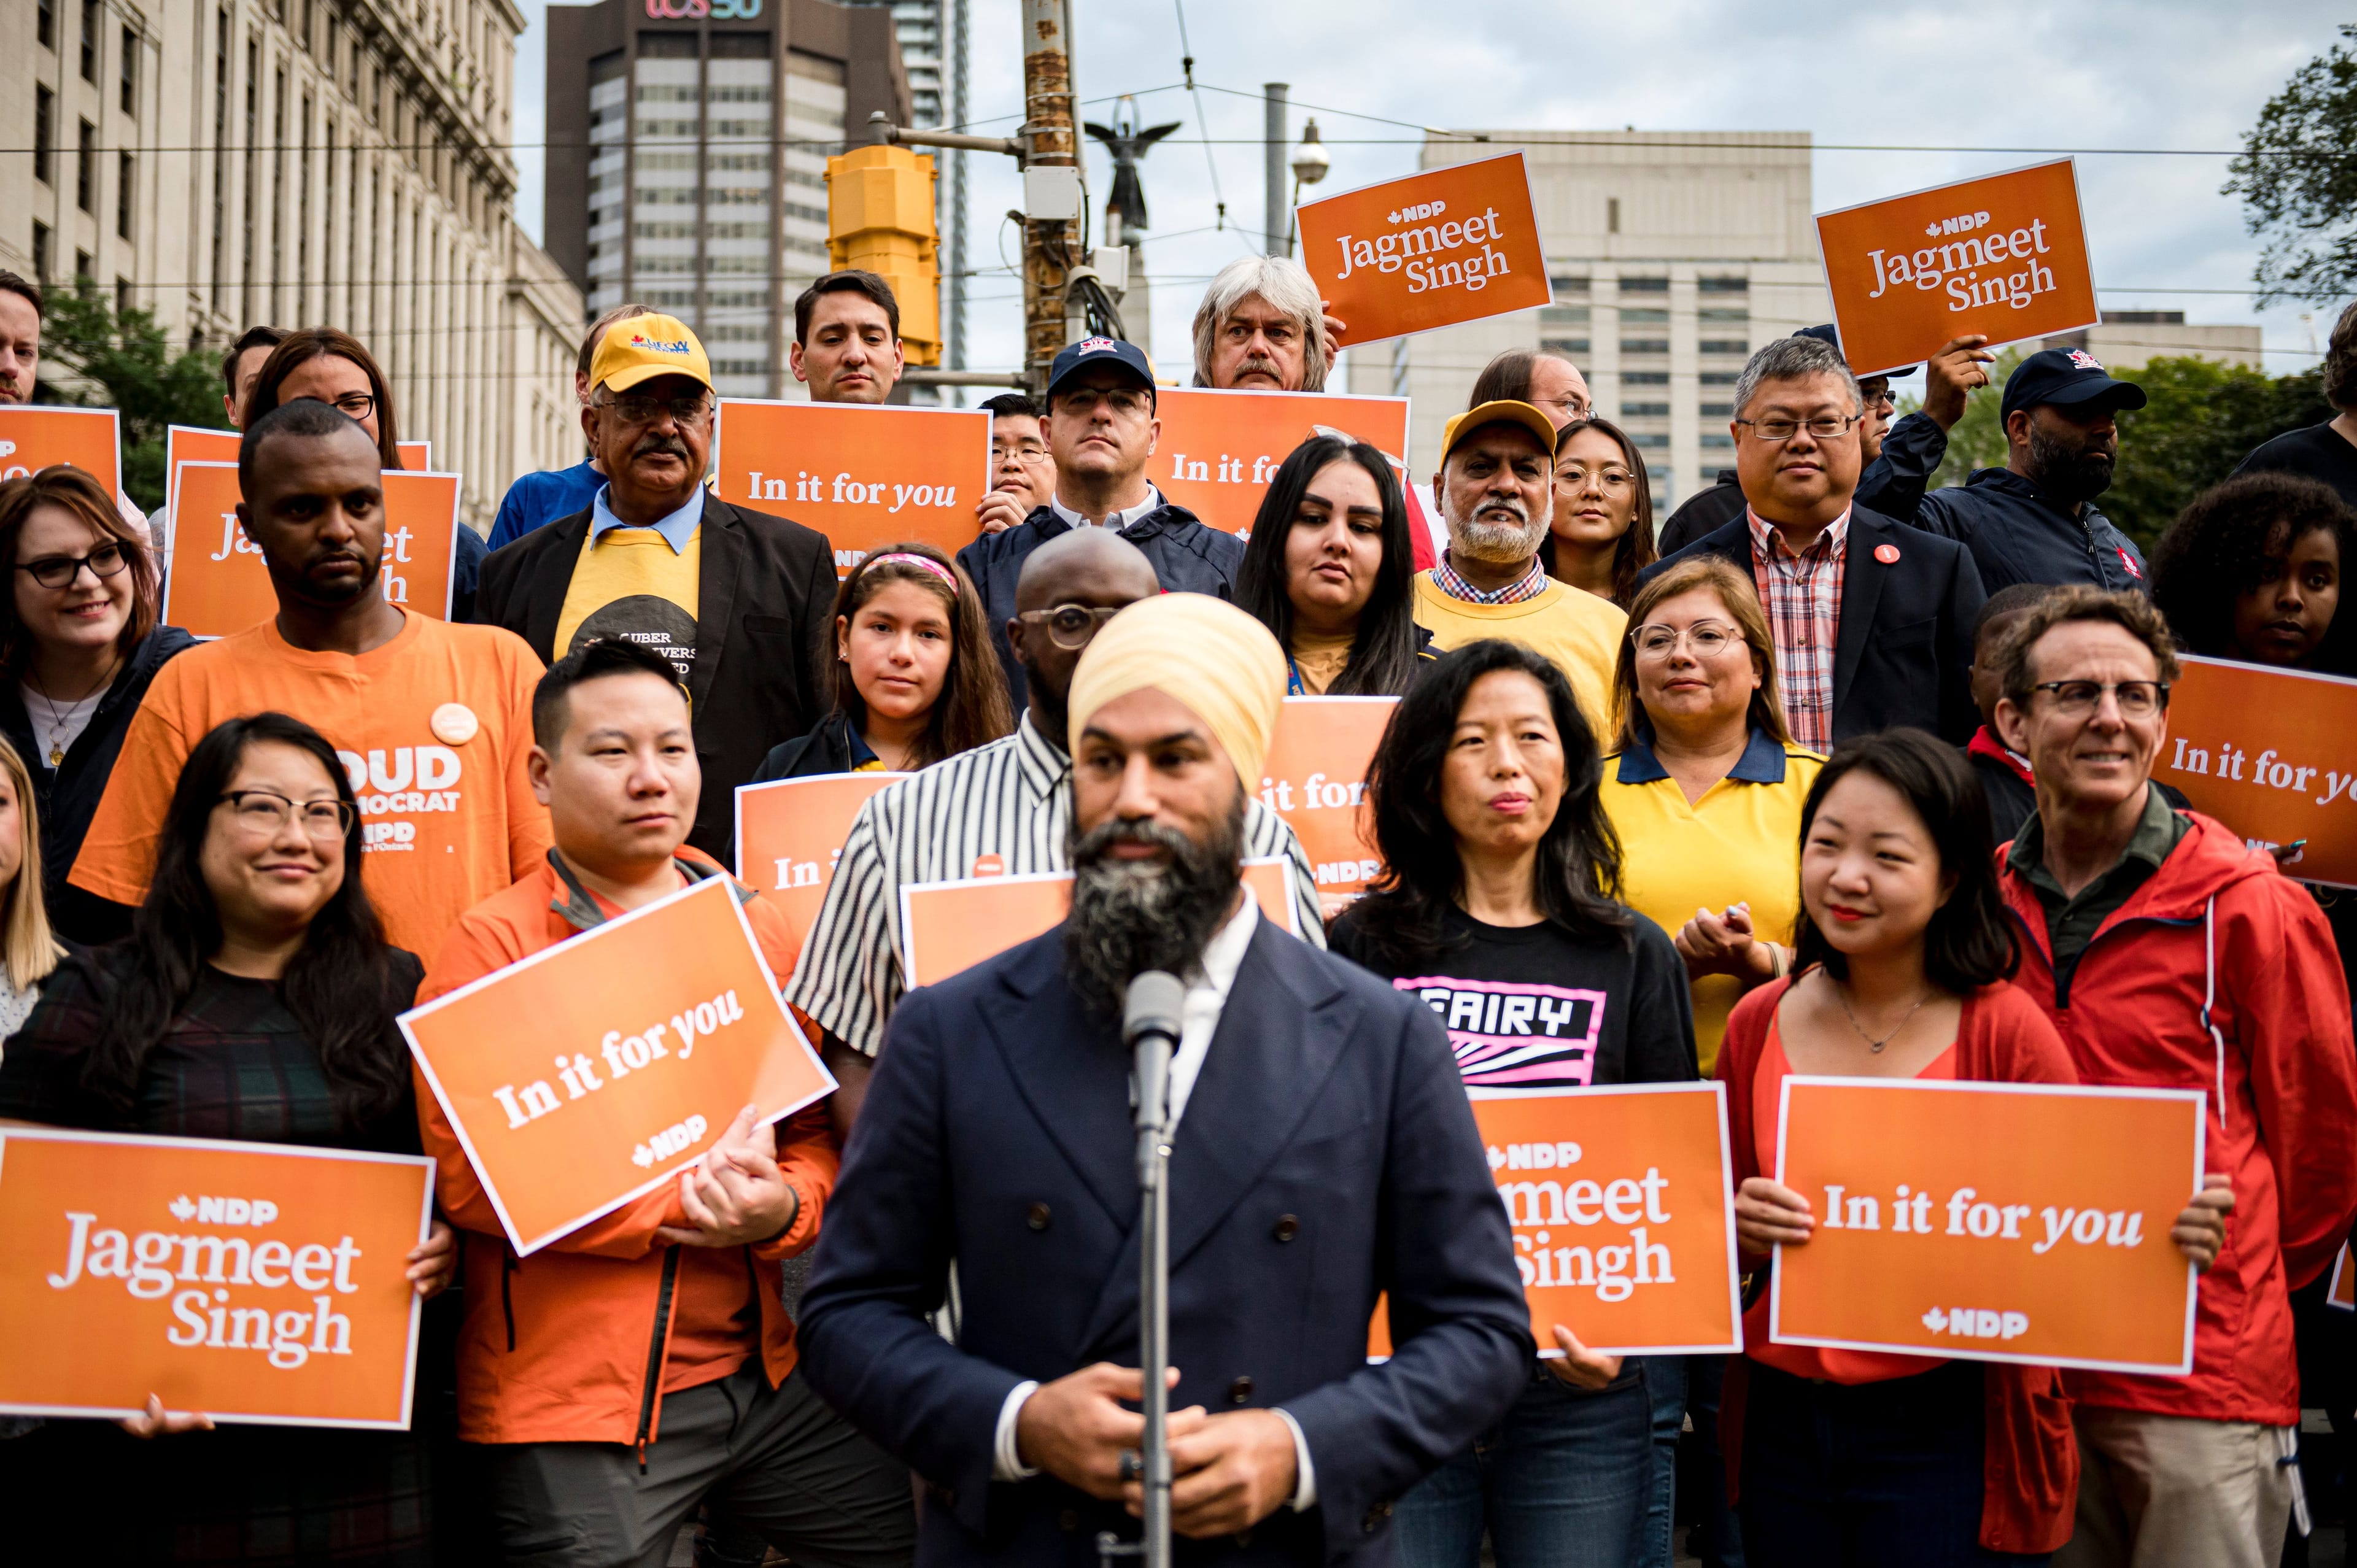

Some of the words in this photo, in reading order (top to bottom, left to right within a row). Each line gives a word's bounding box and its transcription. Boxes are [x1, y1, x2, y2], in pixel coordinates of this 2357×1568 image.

[1402, 200, 1446, 223] NDP
[1942, 210, 1991, 236] NDP
[1336, 207, 1503, 280] Jagmeet
[1867, 218, 2051, 298] Jagmeet
[1406, 244, 1511, 293] Singh
[1946, 257, 2057, 312] Singh
[1171, 454, 1209, 482] In
[1217, 454, 1244, 484] it
[748, 471, 788, 501] In
[796, 471, 823, 503] it
[832, 472, 886, 504] for
[888, 484, 956, 514] you
[834, 549, 868, 568] ND
[630, 632, 672, 644] UBER
[2170, 737, 2209, 774] In
[2216, 742, 2246, 781] it
[2252, 749, 2318, 792] for
[1260, 776, 1296, 812] it
[1302, 771, 1369, 809] for
[774, 857, 821, 890] In
[1317, 859, 1381, 885] NDP
[493, 1079, 562, 1130] In
[554, 1052, 604, 1100] it
[600, 1023, 669, 1079] for
[670, 989, 744, 1059] you
[649, 1114, 708, 1162] NDP
[1507, 1141, 1582, 1171] NDP
[197, 1197, 279, 1227] NDP
[1498, 1167, 1672, 1227] meet
[1822, 1184, 1881, 1230] In
[1892, 1184, 1933, 1234] it
[1945, 1187, 2032, 1239] for
[2032, 1205, 2143, 1254] you
[47, 1211, 362, 1299] Jagmeet
[167, 1289, 352, 1369] Singh
[1948, 1307, 2029, 1340] NDP
